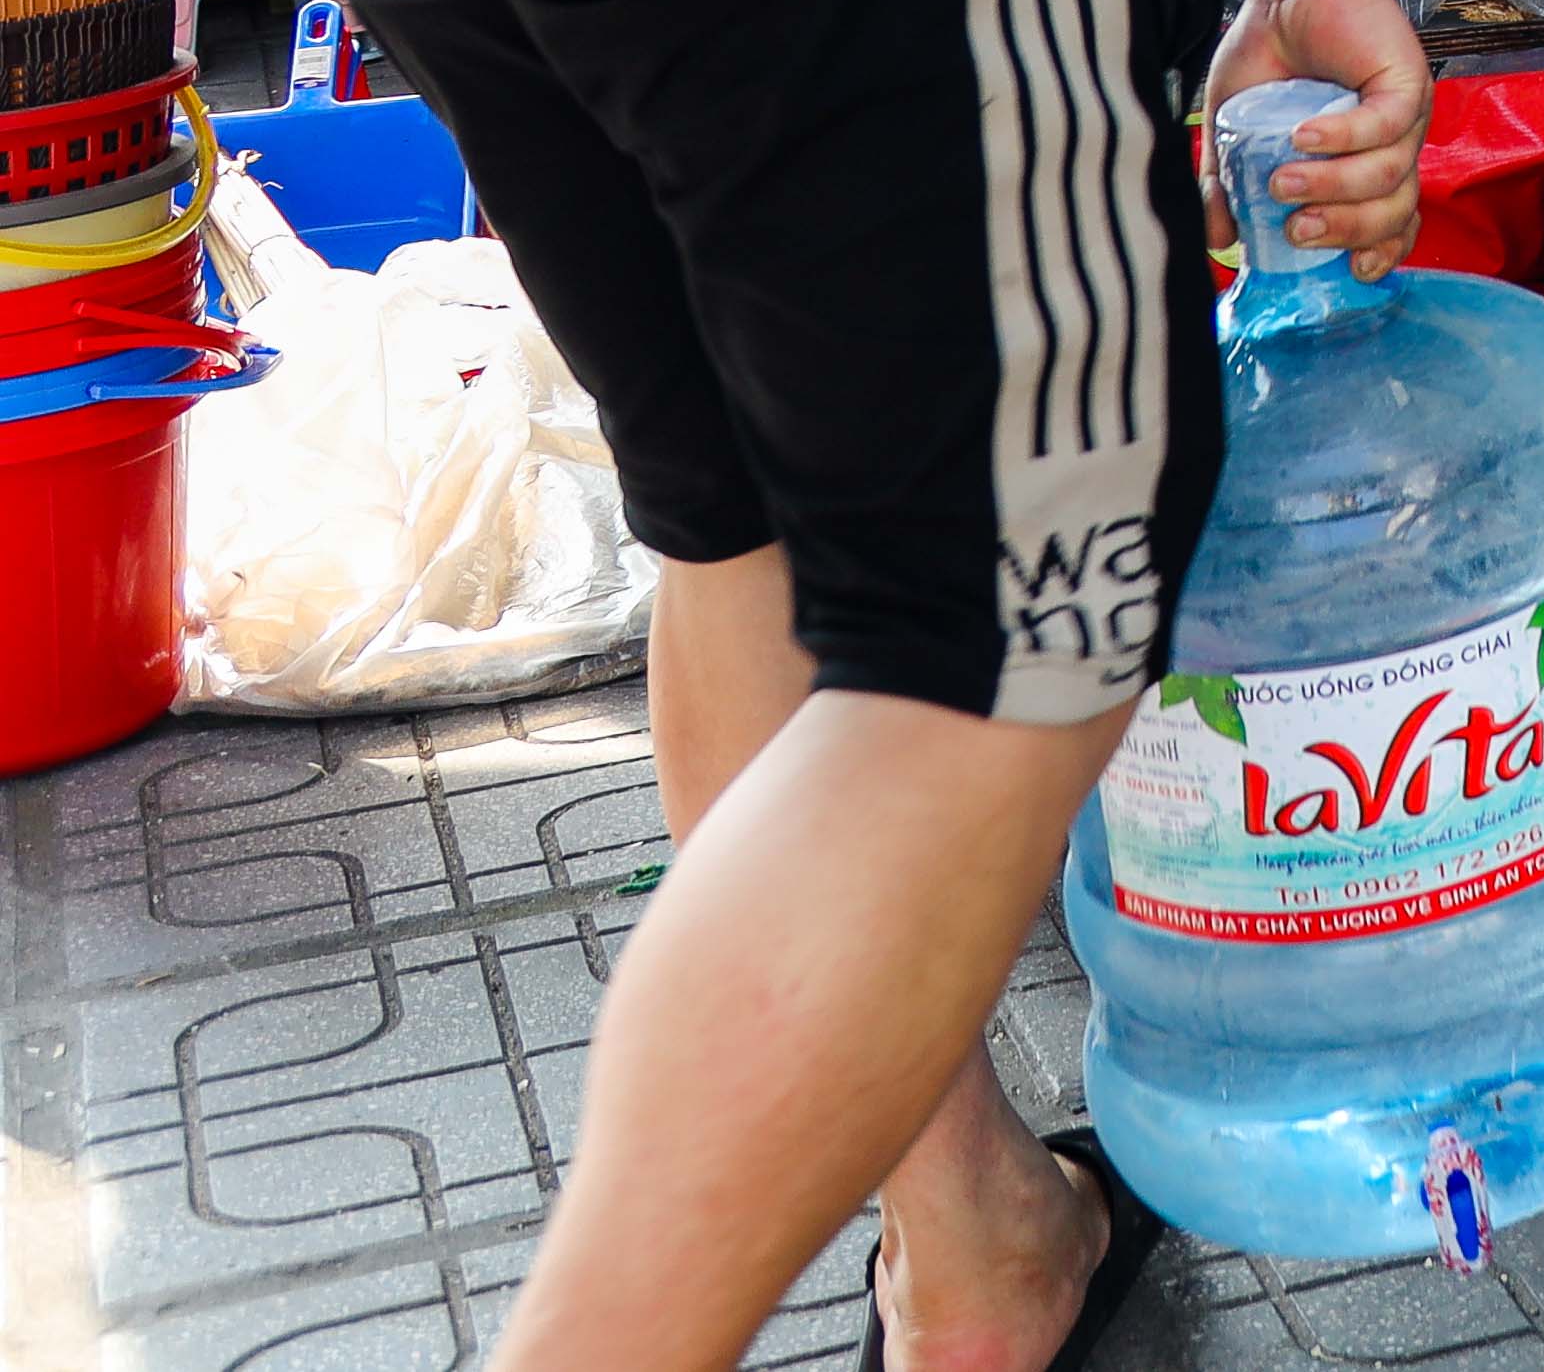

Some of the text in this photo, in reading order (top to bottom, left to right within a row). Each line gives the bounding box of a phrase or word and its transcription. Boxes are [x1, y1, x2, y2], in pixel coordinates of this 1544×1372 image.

[1459, 630, 1512, 666] CHAI
[1343, 868, 1420, 901] 0962
[1433, 848, 1486, 881] 172
[1495, 822, 1544, 855] 926
[1493, 866, 1520, 892] AN
